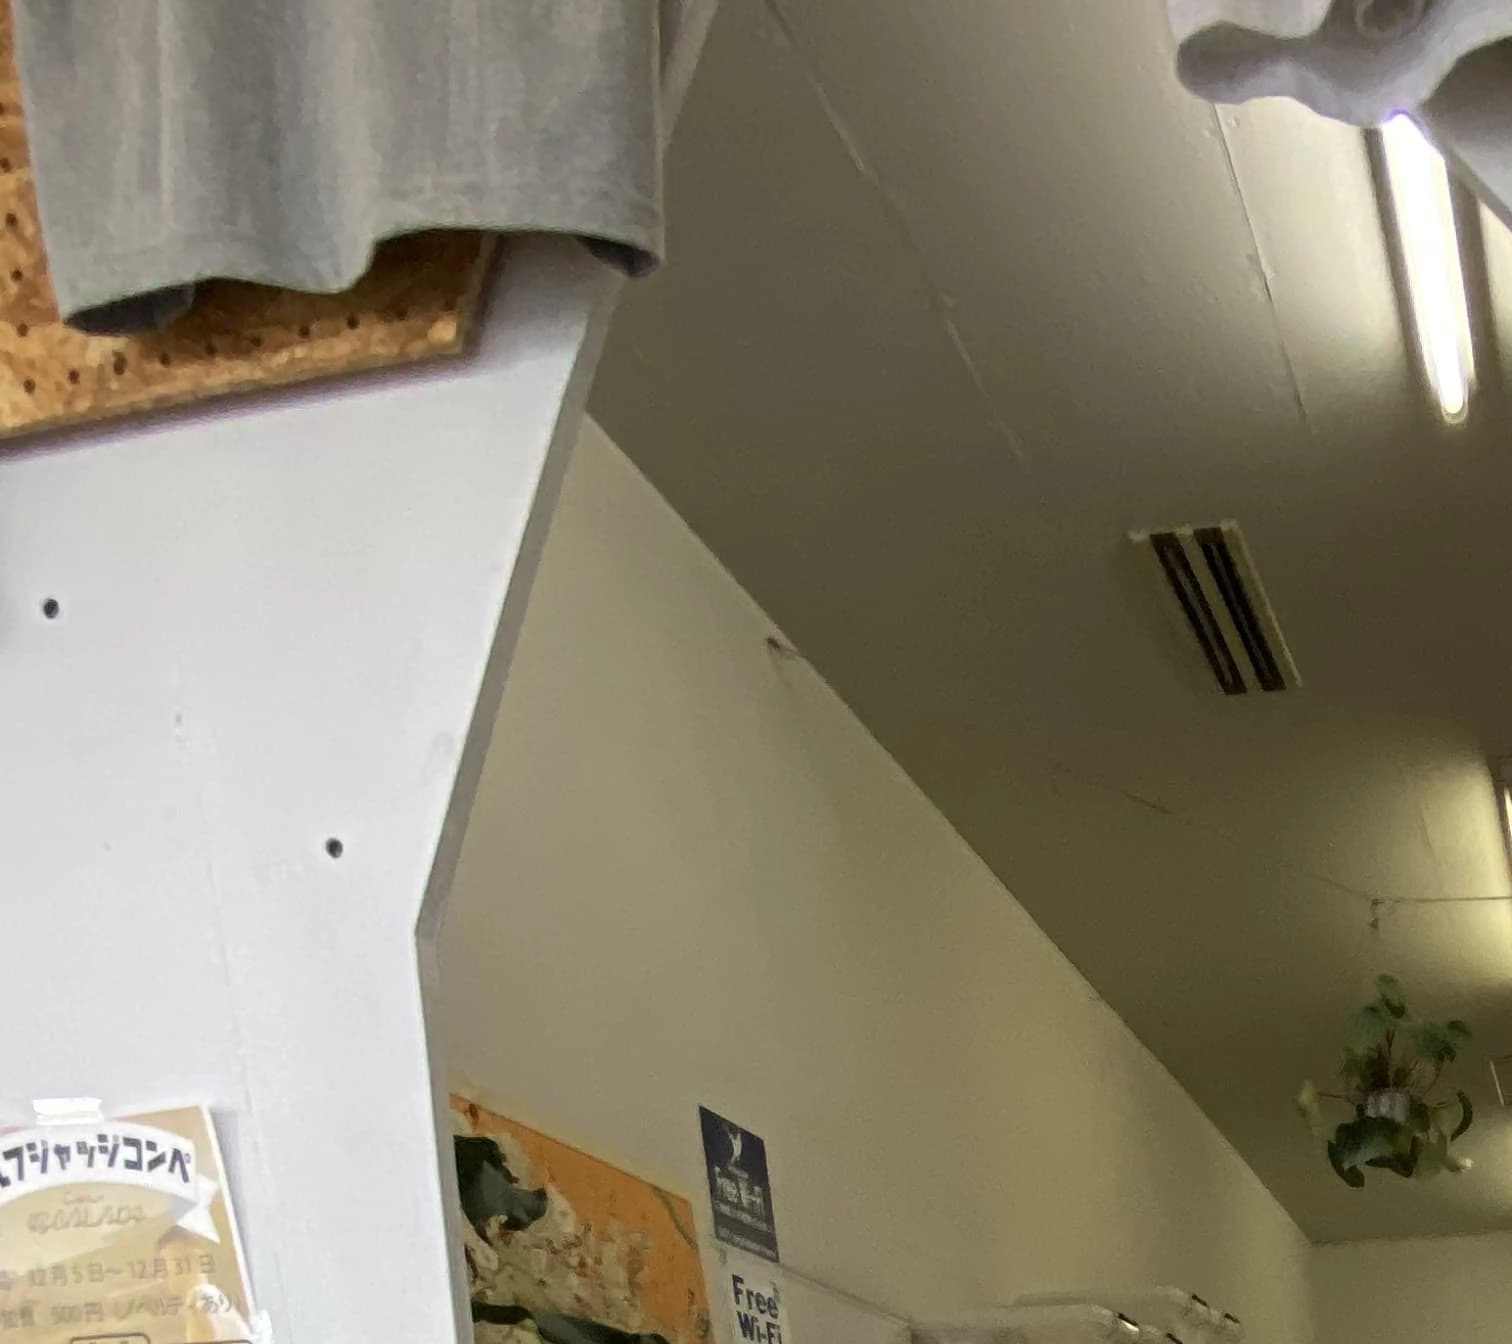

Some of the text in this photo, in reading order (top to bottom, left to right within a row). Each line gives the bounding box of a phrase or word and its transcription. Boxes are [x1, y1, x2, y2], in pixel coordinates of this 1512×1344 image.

[0, 1133, 191, 1188] フジャッジコンペ
[732, 1273, 779, 1319] Free
